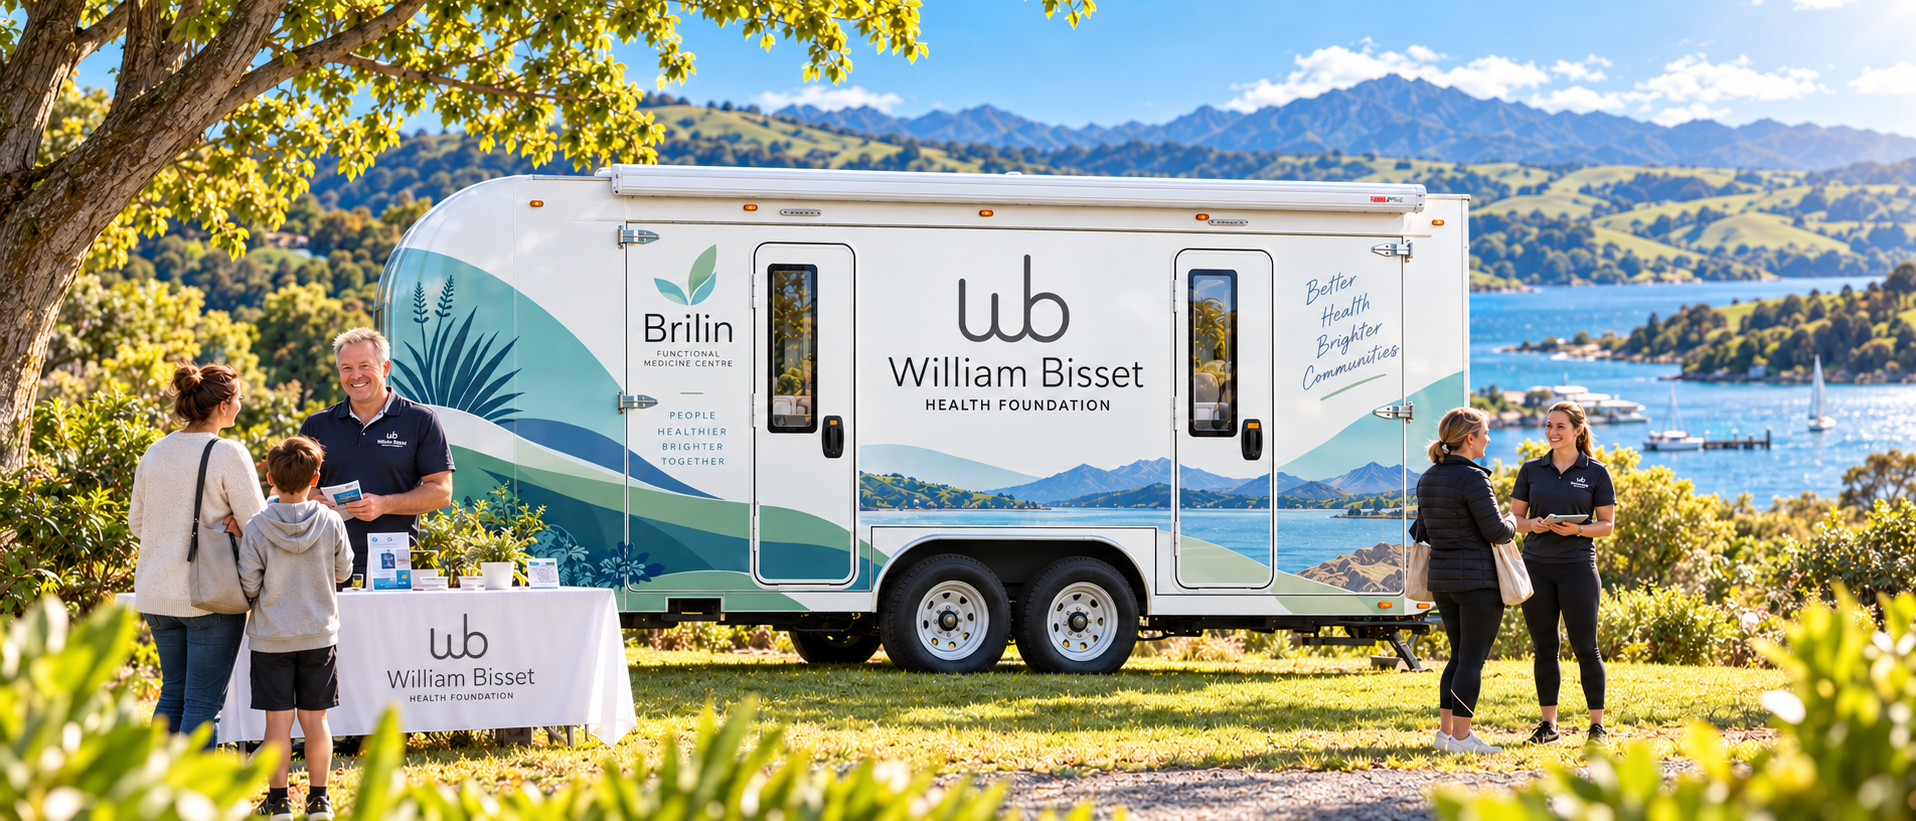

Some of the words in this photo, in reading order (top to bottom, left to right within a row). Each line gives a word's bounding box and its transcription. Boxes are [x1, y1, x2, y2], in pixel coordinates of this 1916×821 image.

[1306, 271, 1357, 306] Better
[1320, 292, 1371, 328] Health
[644, 313, 733, 343] Brilin
[1316, 321, 1383, 359] Brighter
[656, 350, 720, 358] FUNCTIONAL
[643, 359, 691, 367] MEDICINE
[695, 359, 733, 367] CENTRE
[1302, 344, 1400, 391] Communities
[888, 356, 1027, 387] William
[1042, 356, 1144, 388] Bisset
[925, 399, 990, 411] HEALTH
[999, 399, 1110, 411] FOUNDATION
[669, 411, 716, 420] PEOPLE
[657, 428, 727, 436] HEALTHIER
[662, 442, 723, 451] BRIGHTER
[661, 457, 725, 466] TOGETHER
[387, 669, 465, 689] William
[474, 667, 535, 687] Bisset
[409, 694, 447, 703] HEALTH
[450, 692, 514, 701] FOUNDATION
